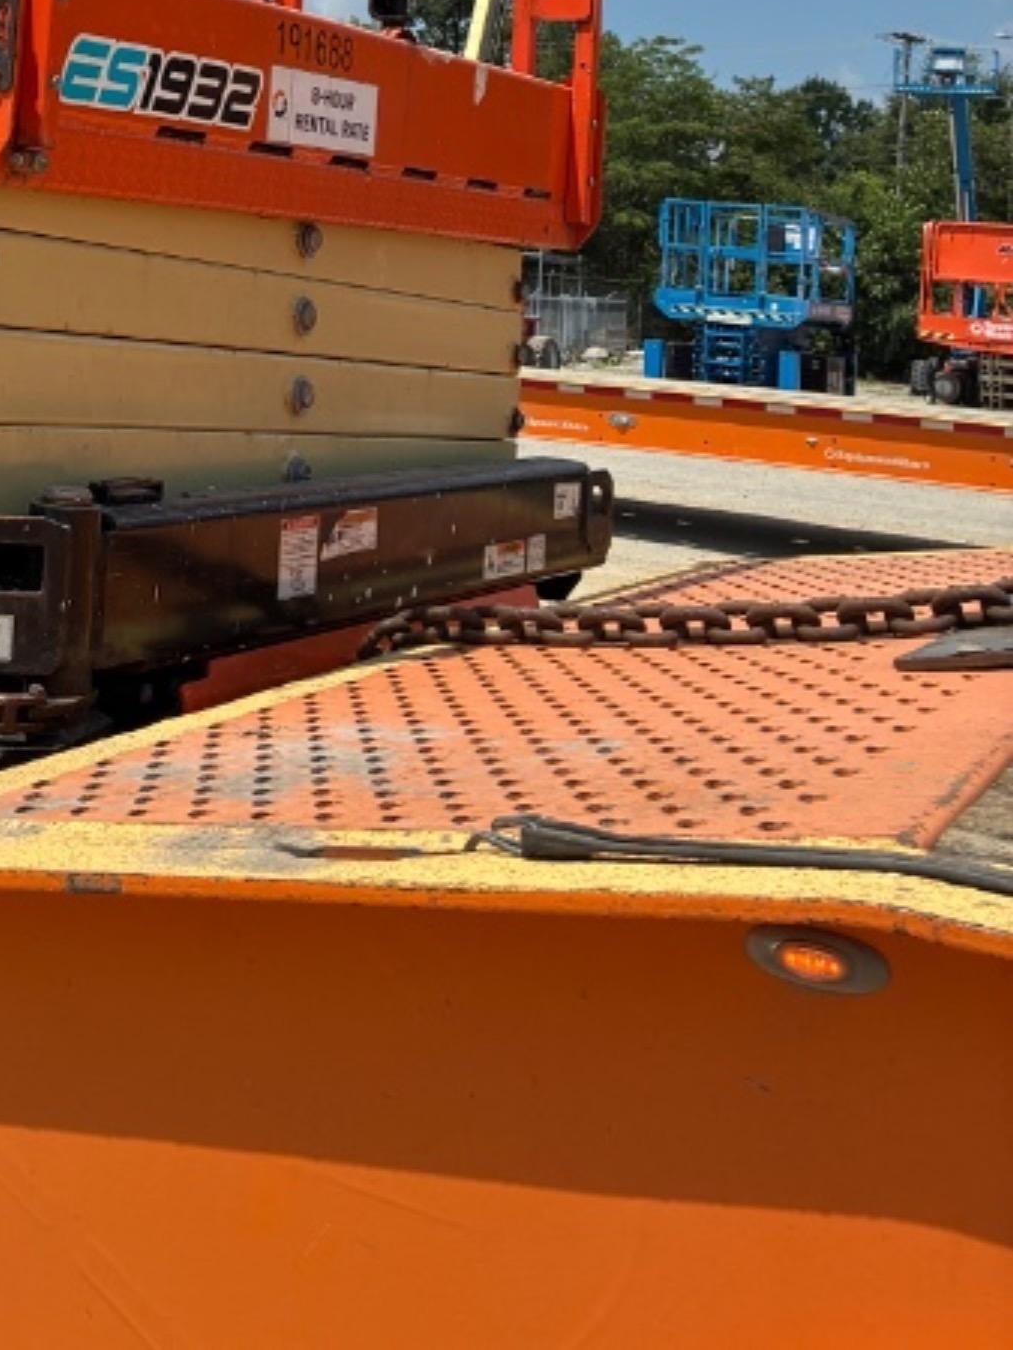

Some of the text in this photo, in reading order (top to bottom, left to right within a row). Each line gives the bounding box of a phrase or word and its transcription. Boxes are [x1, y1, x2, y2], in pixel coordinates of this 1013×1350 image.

[59, 33, 263, 131] ES1932
[295, 113, 370, 142] RENTAL RATE
